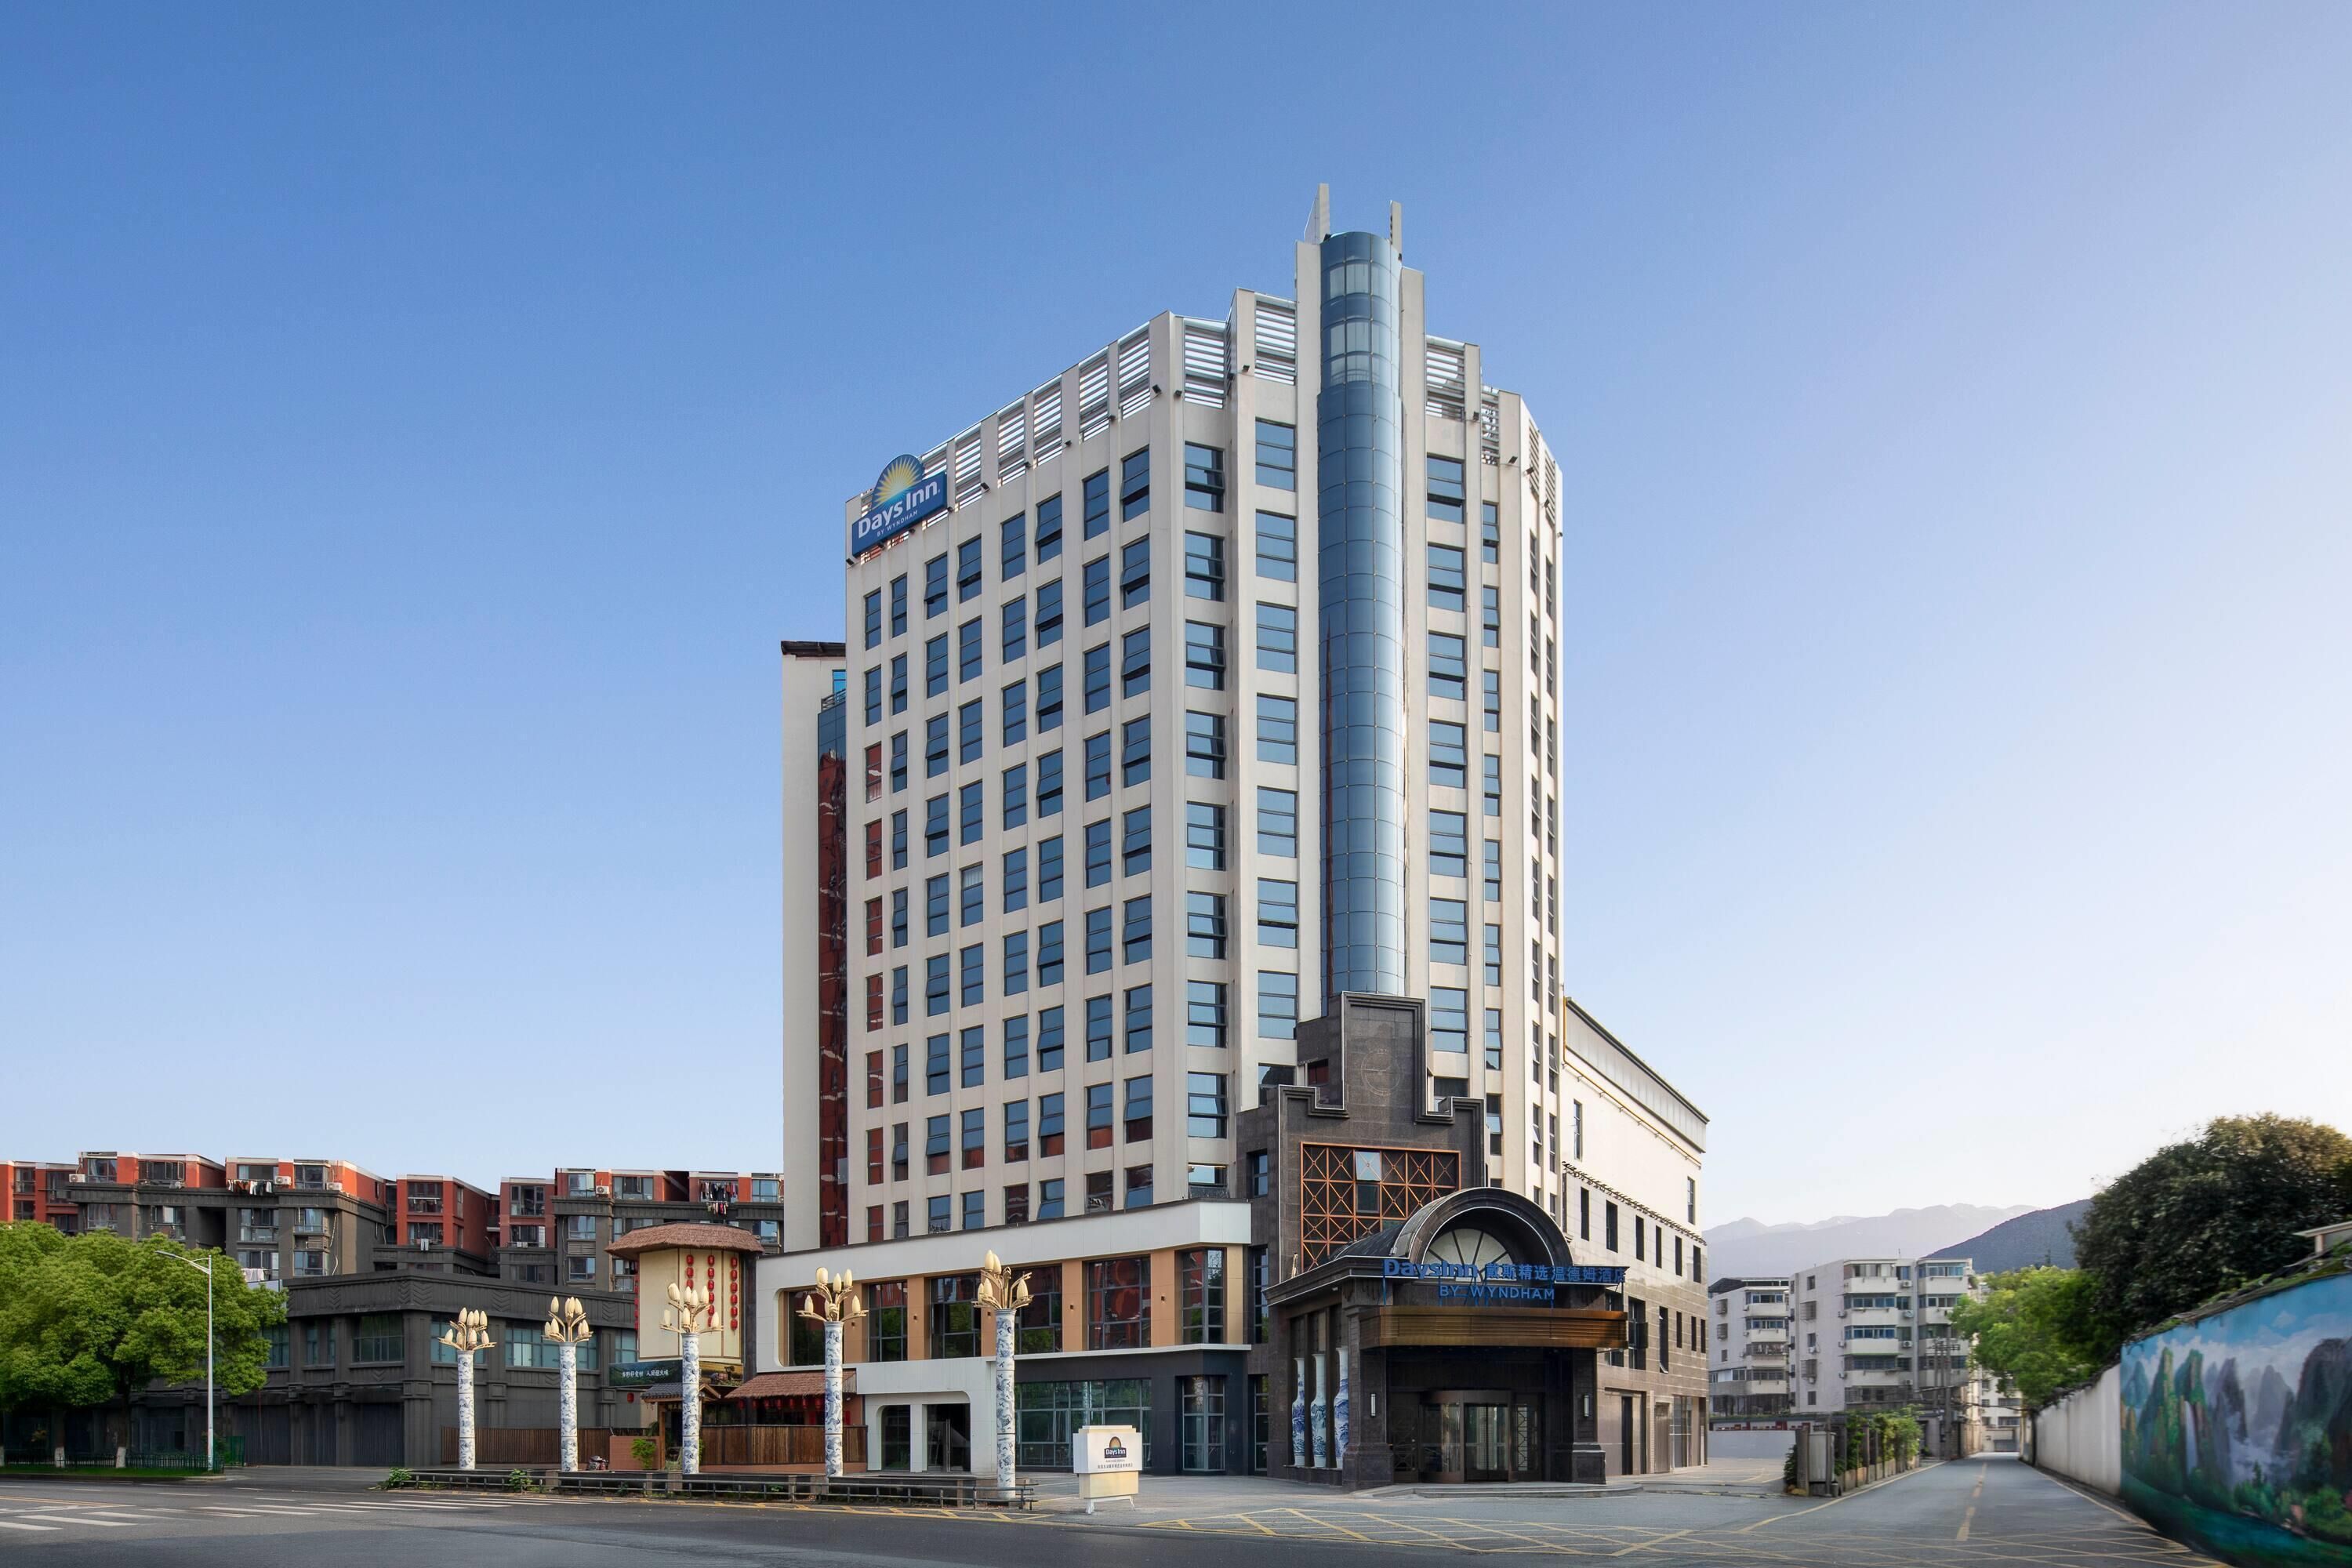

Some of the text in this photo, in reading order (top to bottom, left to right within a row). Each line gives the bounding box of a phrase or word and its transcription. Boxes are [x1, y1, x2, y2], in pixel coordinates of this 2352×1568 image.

[858, 481, 938, 539] Days Inn
[877, 510, 917, 537] BY WYNDHAM
[1384, 1258, 1441, 1279] Days
[1486, 1263, 1624, 1283] 戴斯精选温德姆酒店
[1440, 1286, 1555, 1300] BY WYNDHAM
